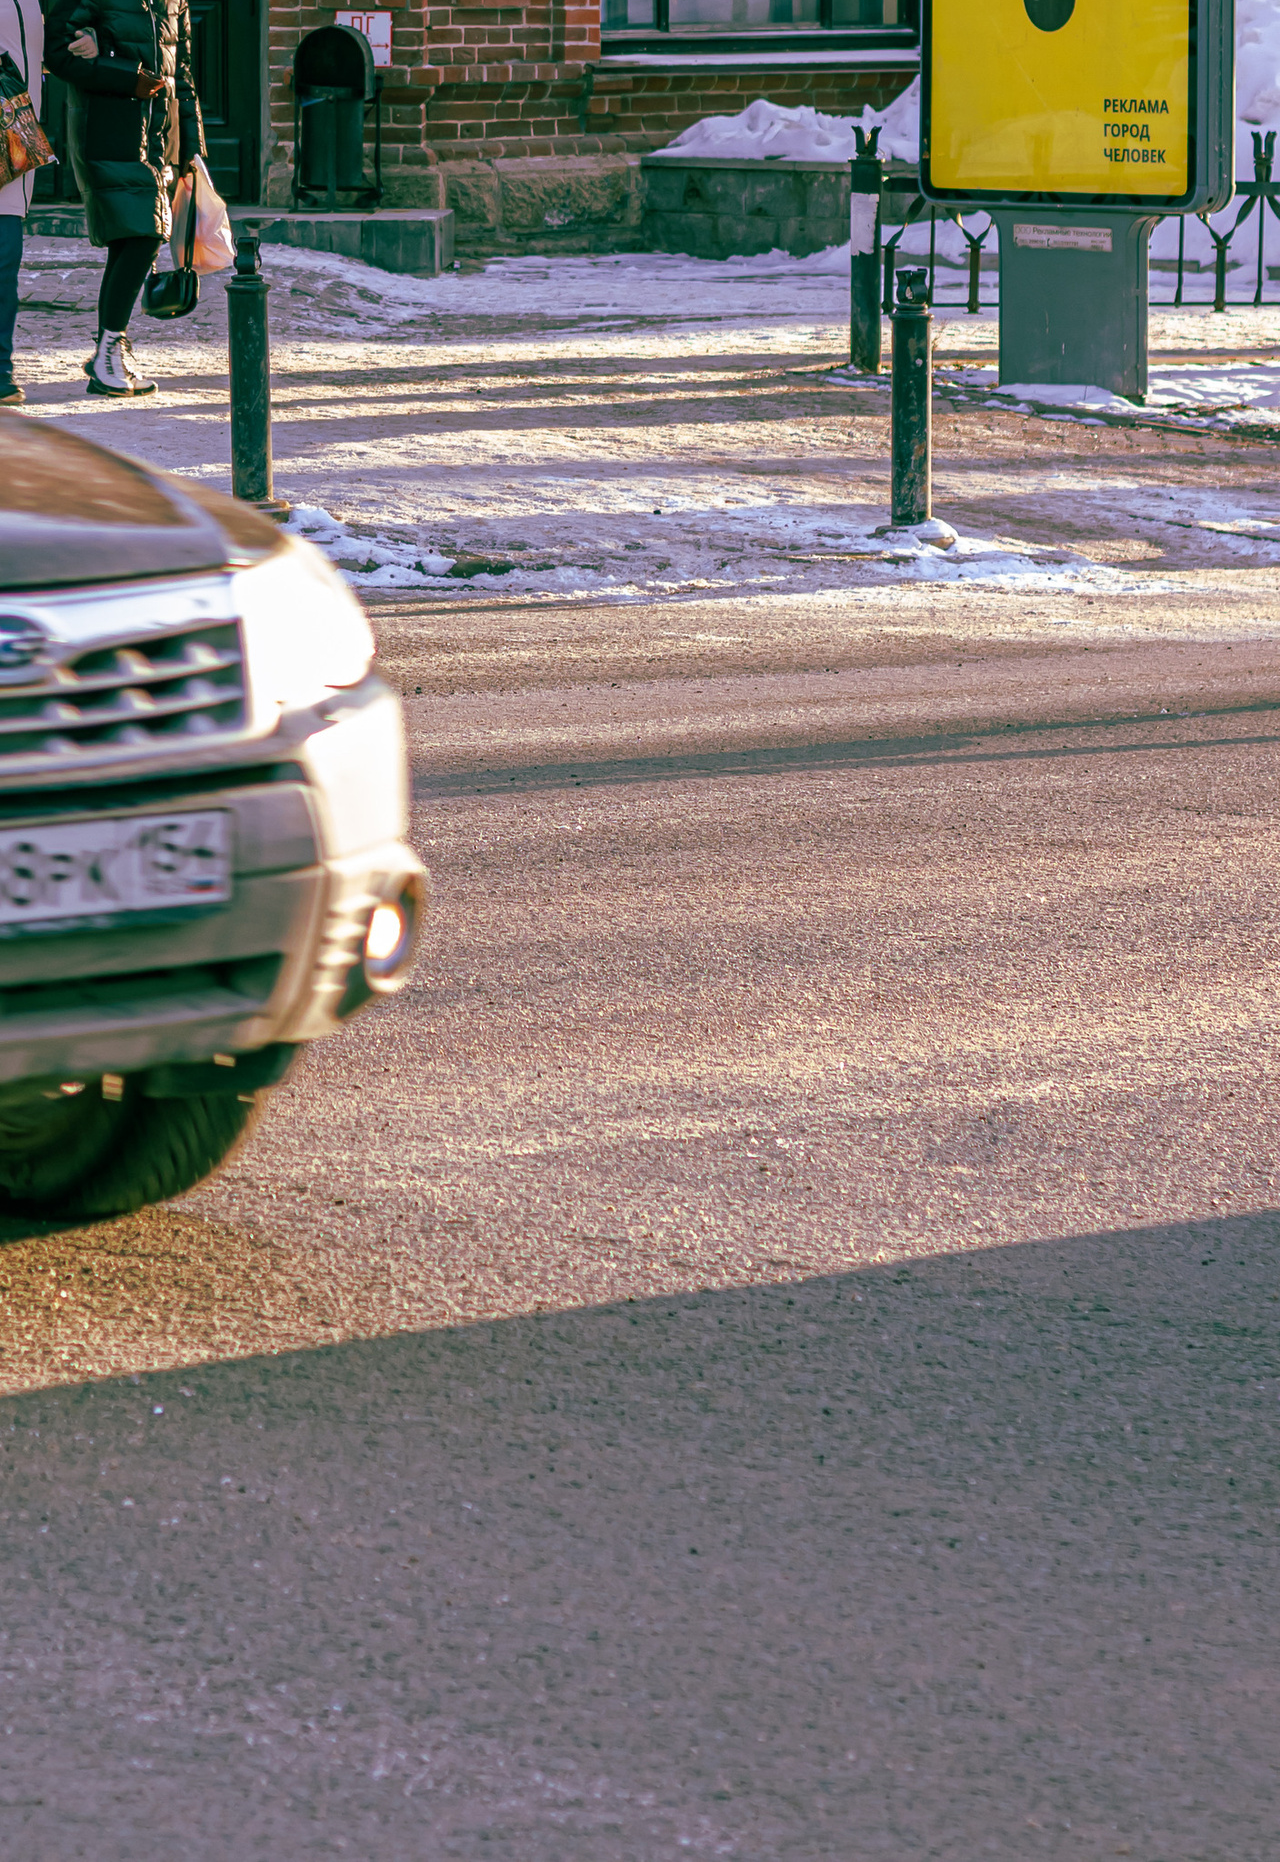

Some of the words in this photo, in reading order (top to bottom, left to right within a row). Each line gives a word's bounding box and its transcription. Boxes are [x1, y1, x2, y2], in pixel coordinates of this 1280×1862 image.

[1103, 98, 1169, 114] РЕКЛАМА
[1103, 124, 1150, 142] ГОРОД
[1103, 148, 1166, 164] ЧЕЛОВЕК
[1032, 227, 1071, 237] Рекламные
